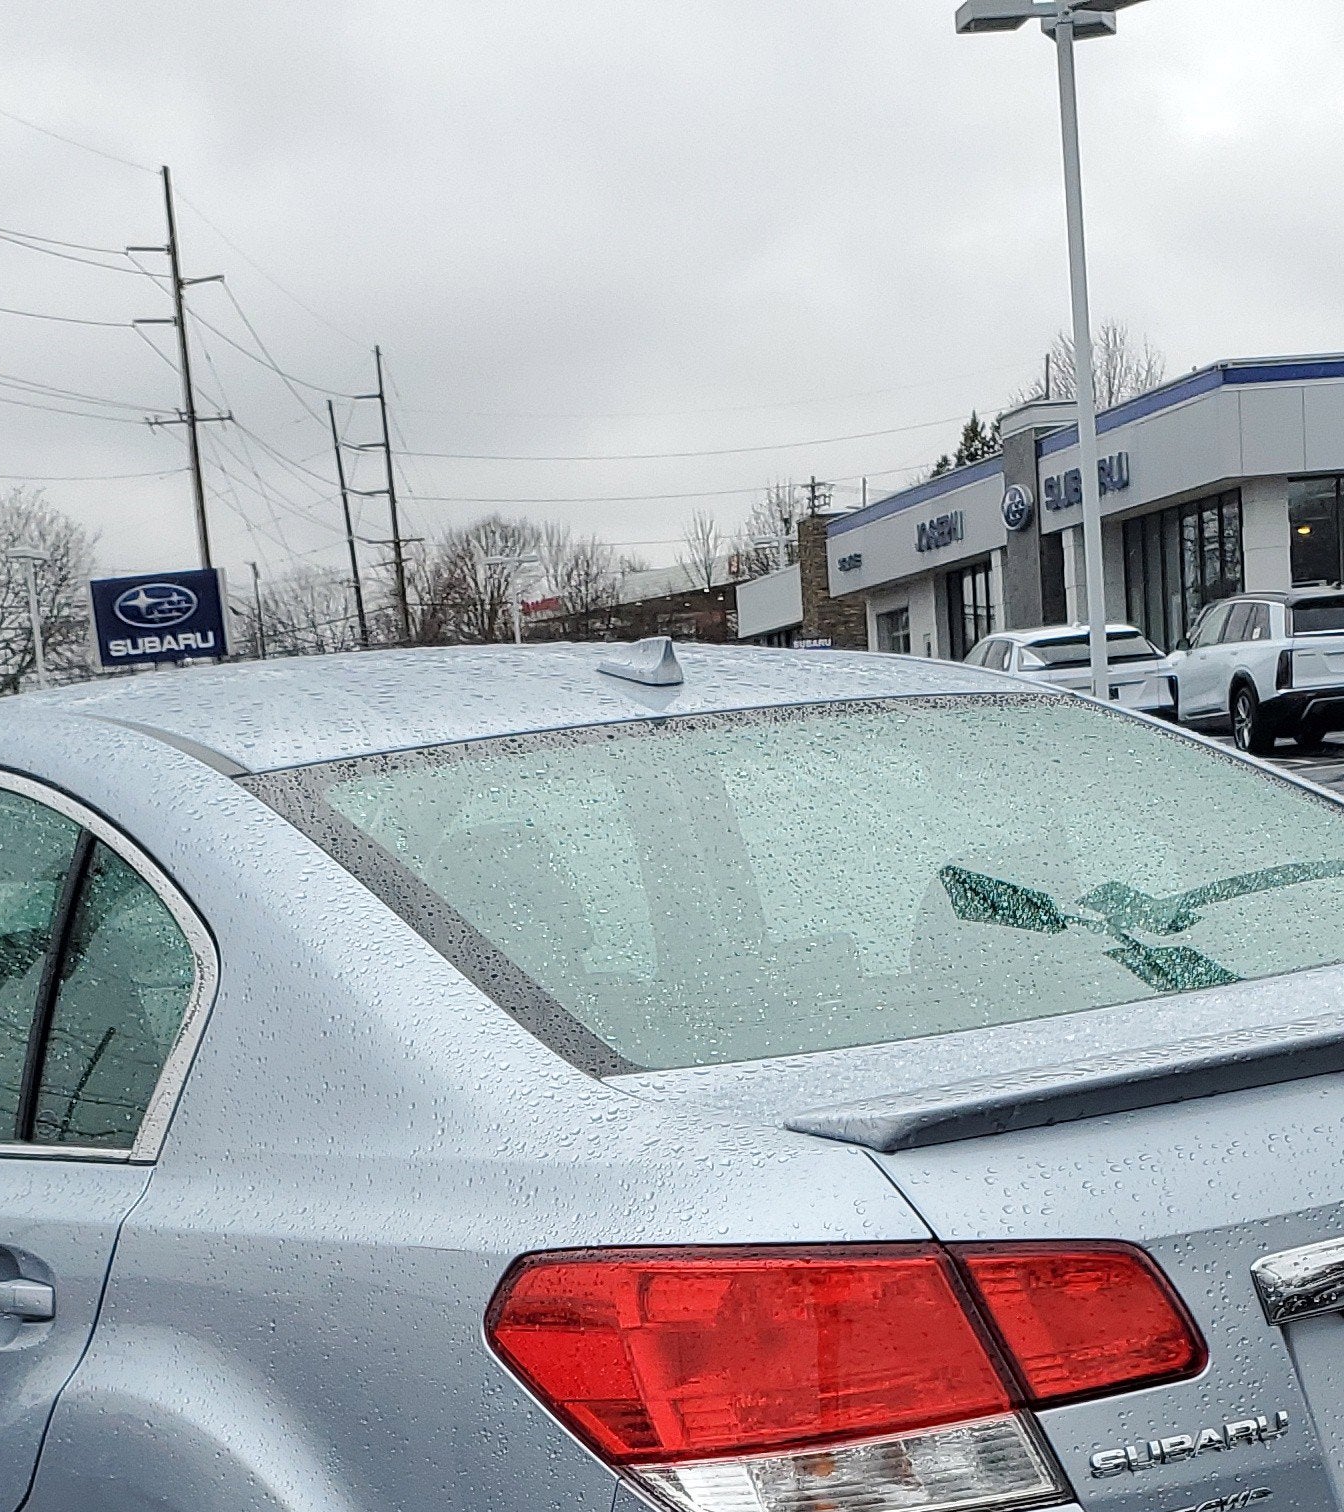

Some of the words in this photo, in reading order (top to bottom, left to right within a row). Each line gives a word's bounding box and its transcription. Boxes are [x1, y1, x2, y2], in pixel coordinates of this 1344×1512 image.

[1044, 451, 1129, 513] SUBRU
[108, 630, 215, 657] SUBARU
[793, 637, 832, 649] SUBARU
[1089, 1410, 1289, 1479] SUBARU
